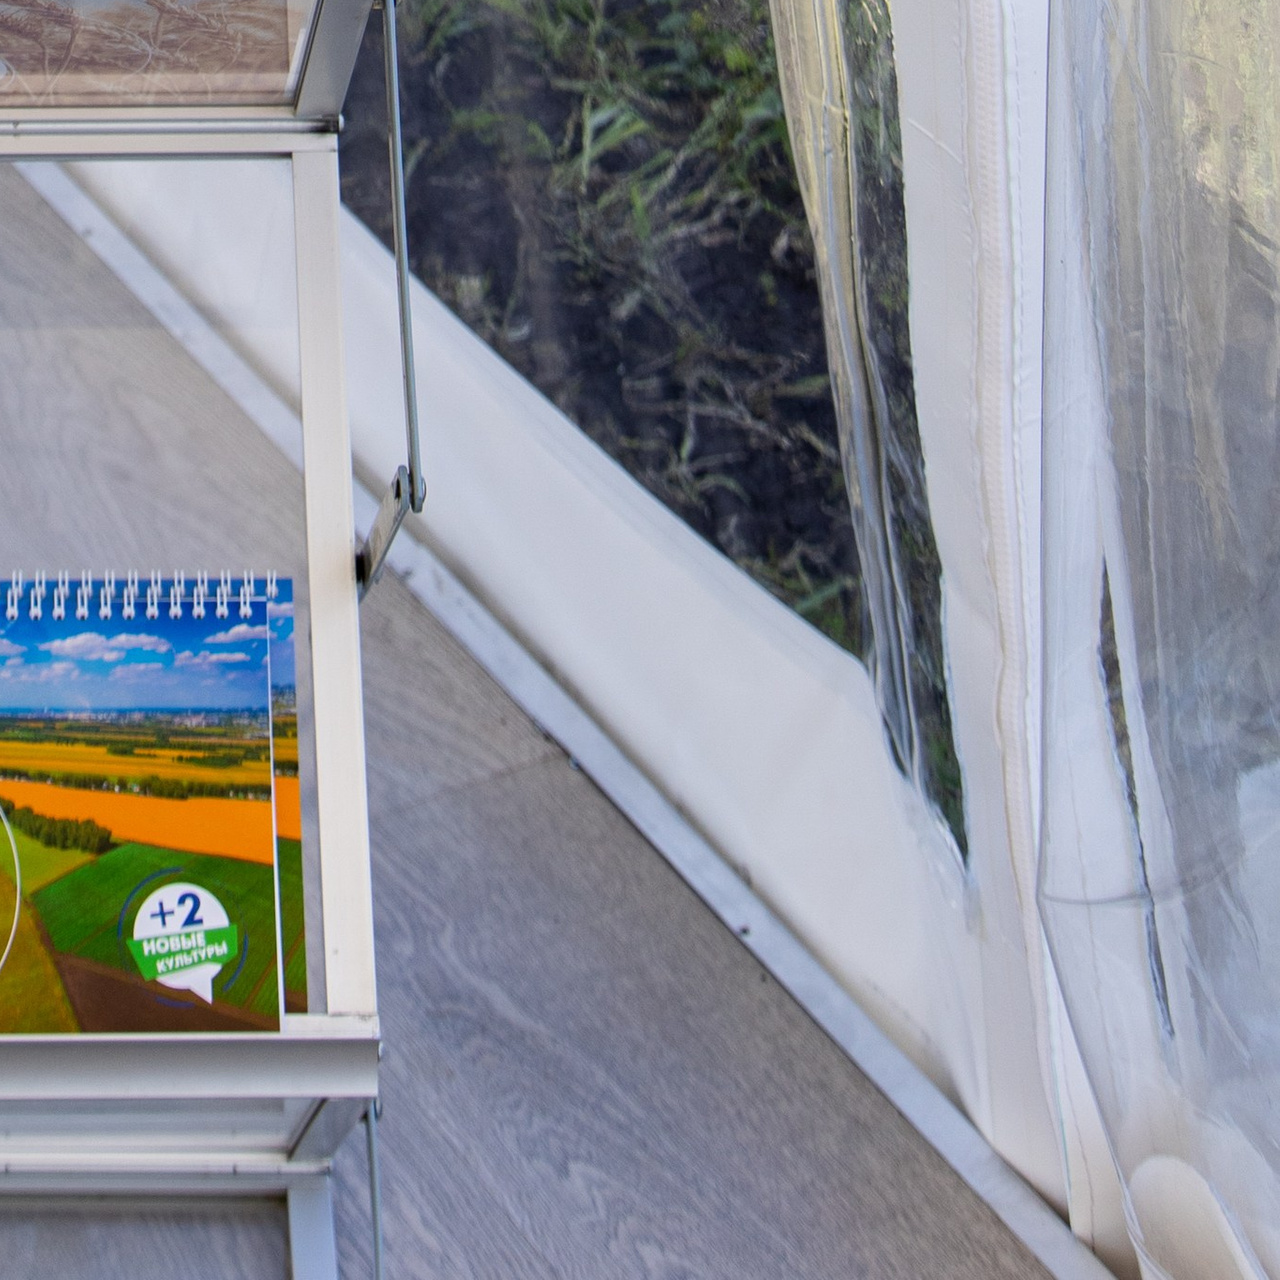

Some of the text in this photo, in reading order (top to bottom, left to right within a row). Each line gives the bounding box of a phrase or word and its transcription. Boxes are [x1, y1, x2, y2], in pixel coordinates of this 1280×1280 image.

[150, 892, 203, 928] +2
[143, 931, 207, 957] НОВЫЕ
[156, 940, 228, 974] КУЛЬТУРЫ
